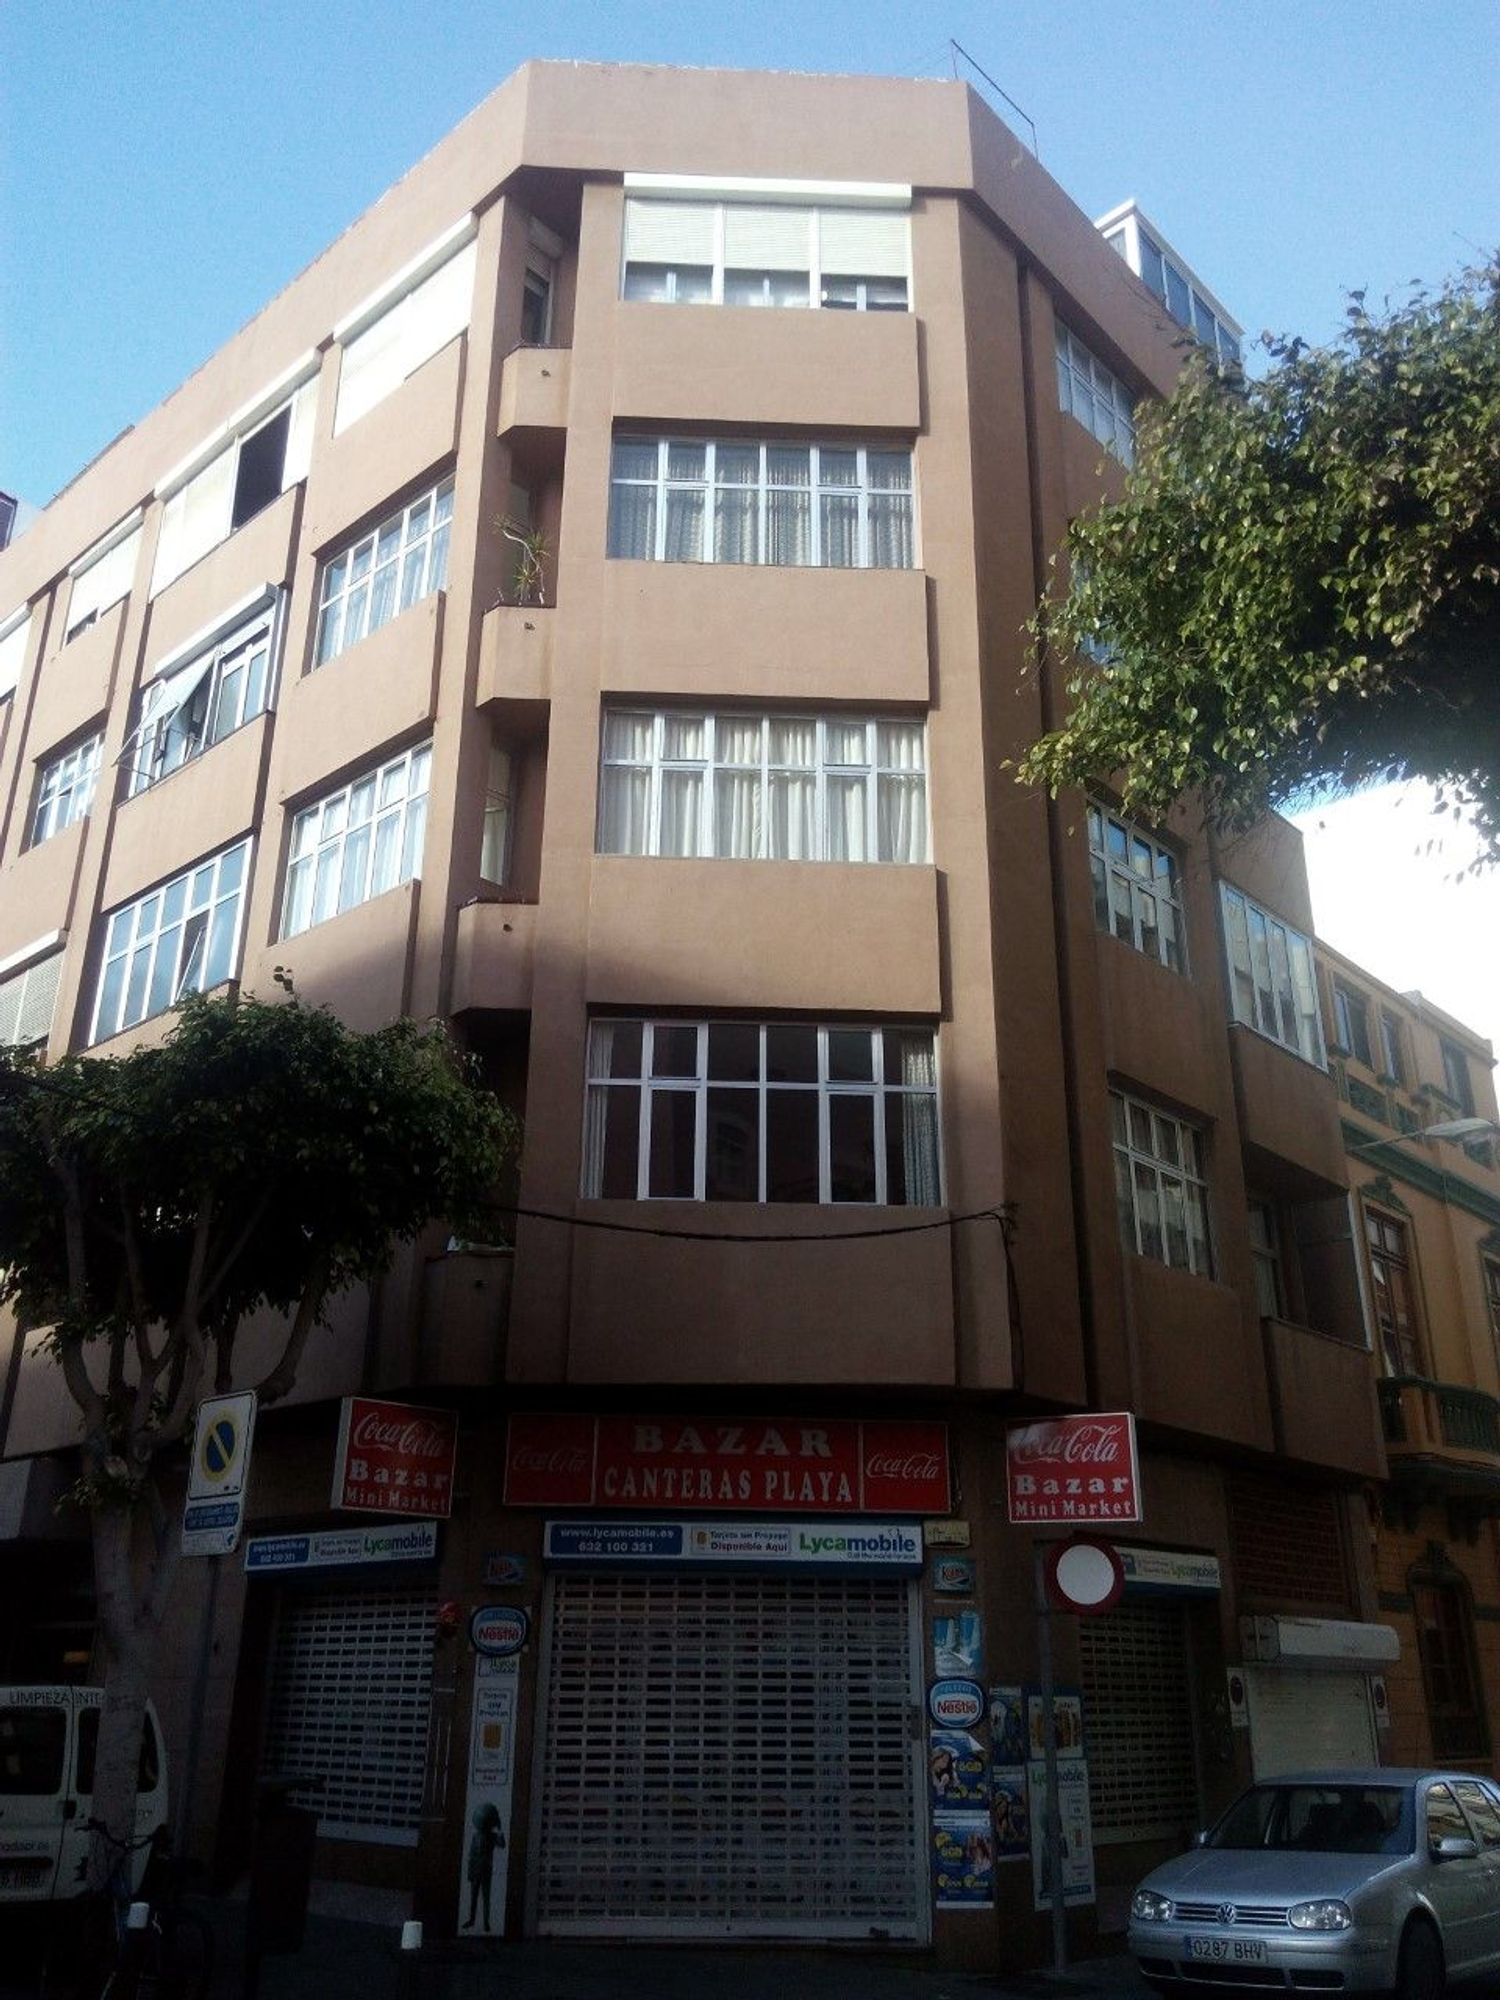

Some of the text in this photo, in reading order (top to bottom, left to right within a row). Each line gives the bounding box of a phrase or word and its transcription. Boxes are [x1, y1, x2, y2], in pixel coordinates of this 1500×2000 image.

[633, 1424, 834, 1456] BAZAR
[350, 1459, 449, 1490] Bazar
[866, 1451, 945, 1479] Coca-Cola
[604, 1467, 854, 1503] CANTERAS PLAYA
[1015, 1475, 1129, 1495] Bazar
[346, 1486, 449, 1512] Mini Market
[1015, 1500, 1130, 1516] Mini Market
[363, 1532, 433, 1556] Lycamobile
[607, 1541, 628, 1553] 100
[711, 1542, 762, 1552] Disponible
[799, 1531, 916, 1555] Lycamobile
[1193, 1940, 1262, 1959] 0287 BHV
